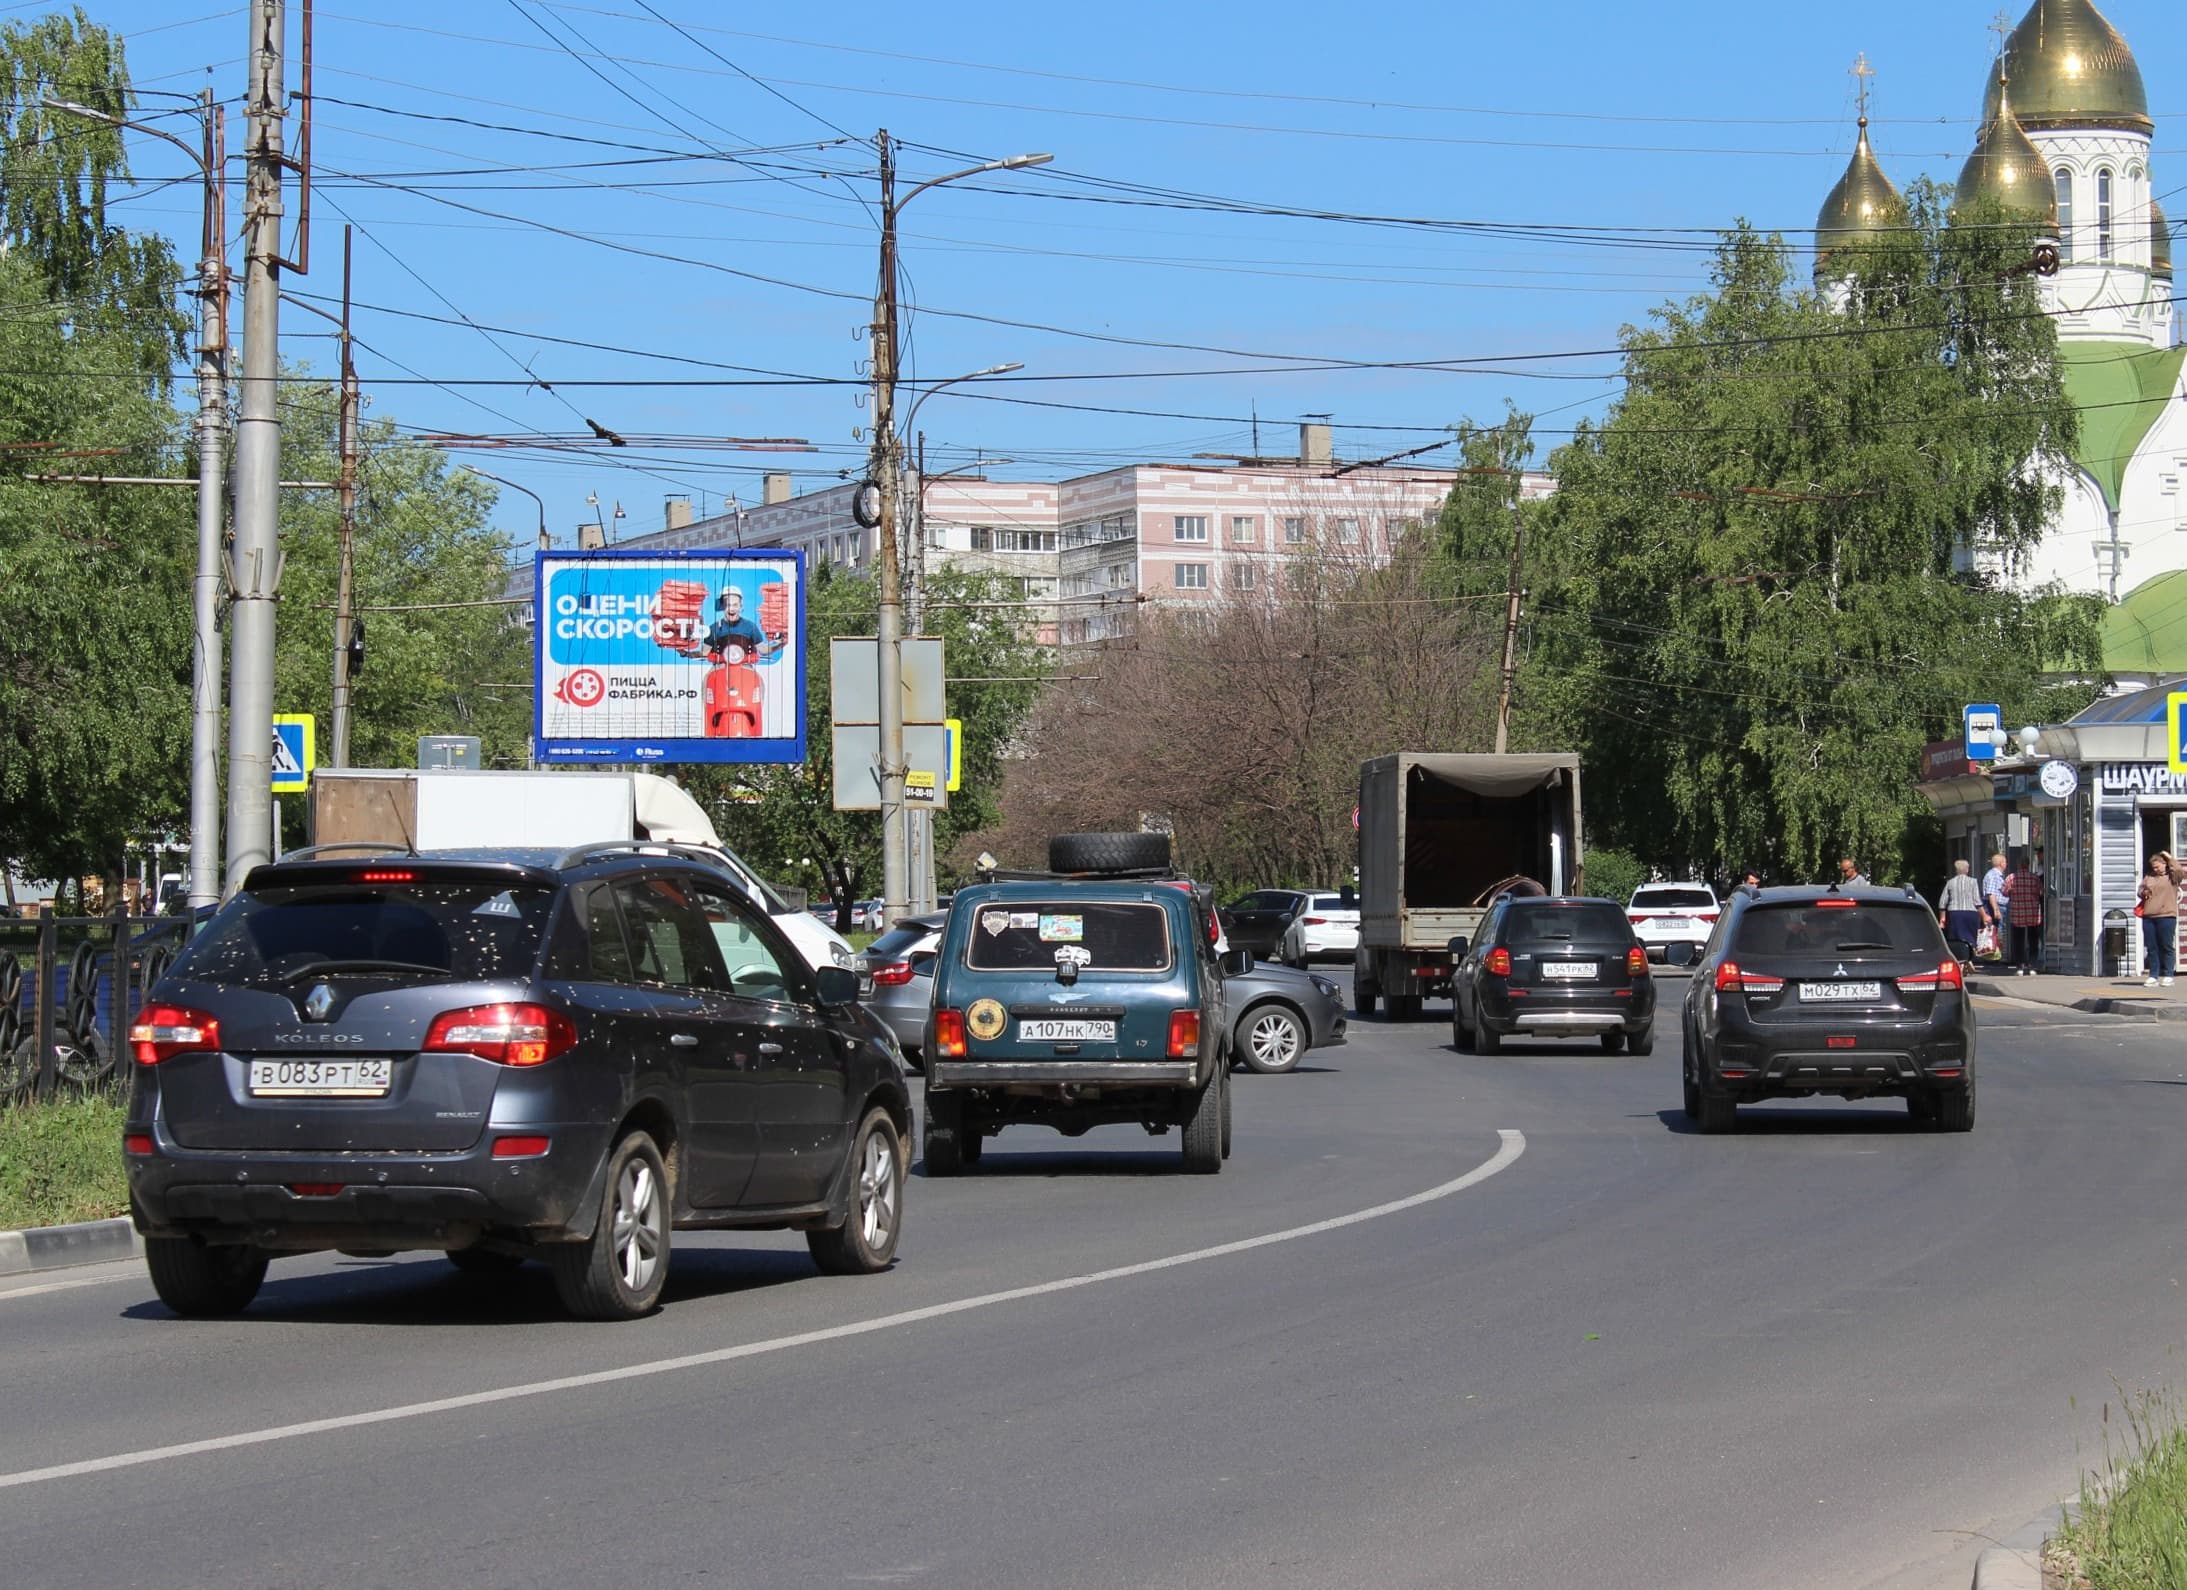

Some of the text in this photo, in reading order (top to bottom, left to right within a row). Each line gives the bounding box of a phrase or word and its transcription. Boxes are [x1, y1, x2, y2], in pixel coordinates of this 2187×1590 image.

[556, 594, 662, 617] ОЦЕНИ
[556, 618, 711, 639] СКОРОСТЬ
[610, 677, 657, 688] ПИЦЦА
[608, 689, 698, 699] ФАБРИКА.РФ
[906, 787, 933, 797] 51-00-19
[275, 1034, 364, 1043] KOLEOS
